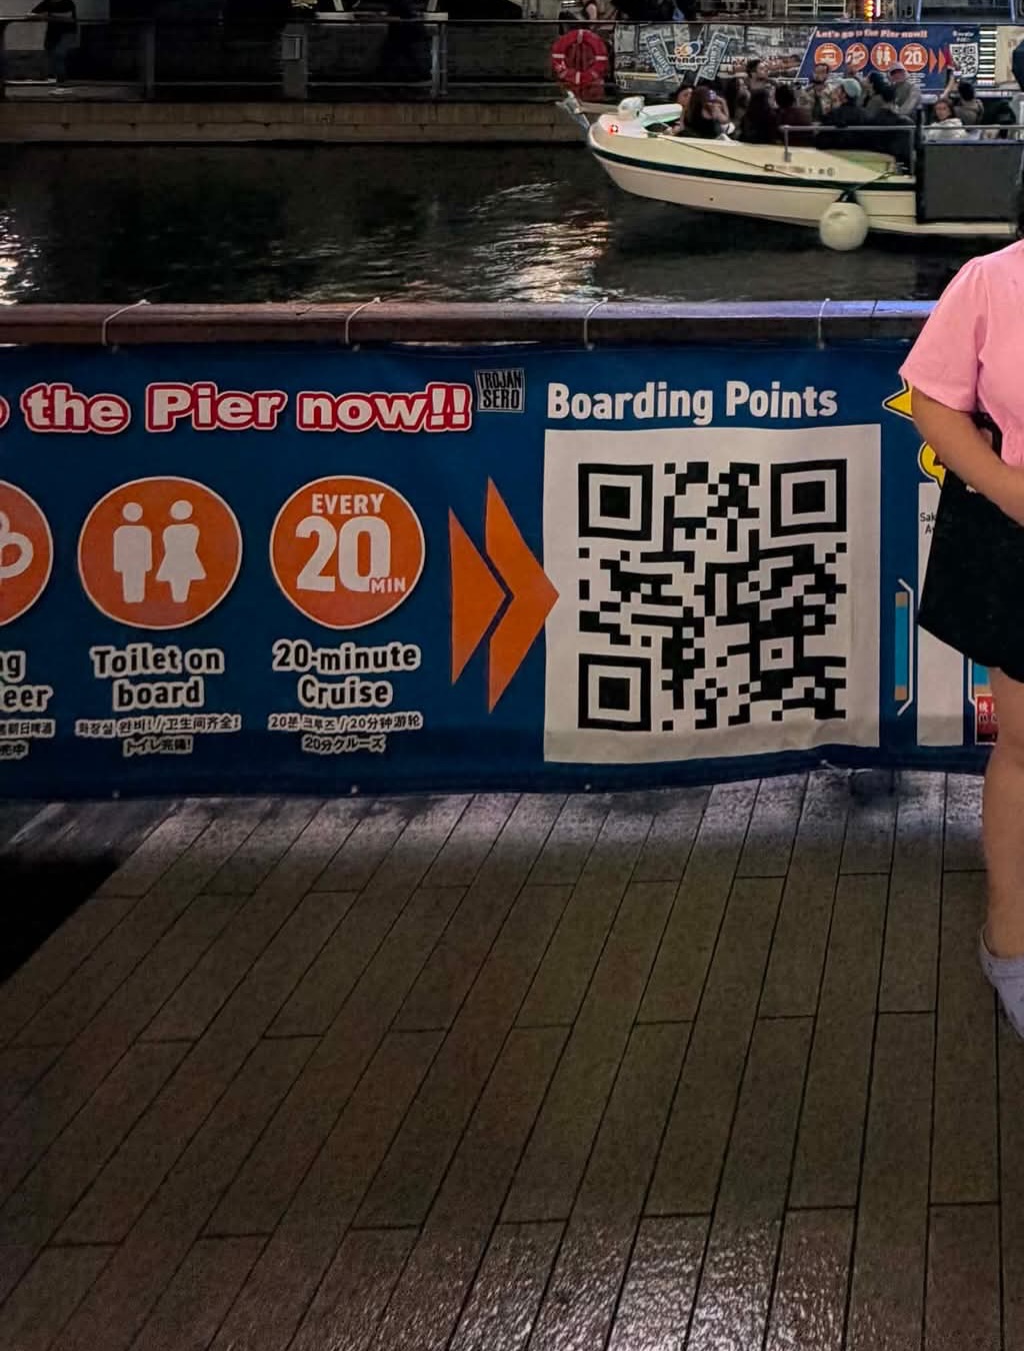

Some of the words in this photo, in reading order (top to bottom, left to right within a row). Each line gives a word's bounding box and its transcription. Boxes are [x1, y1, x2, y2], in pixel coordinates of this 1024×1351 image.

[480, 371, 522, 389] TROJAN
[25, 385, 127, 430] the
[149, 384, 287, 430] Pier
[300, 385, 468, 430] now!!
[547, 381, 714, 425] Boarding
[726, 380, 839, 417] Points
[311, 493, 385, 515] EVERY
[295, 515, 392, 593] 20
[370, 577, 406, 594] MIN
[93, 647, 179, 674] Toilet
[189, 650, 221, 670] on
[276, 643, 417, 671] 20-minute
[118, 681, 201, 707] board
[301, 679, 389, 705] Cruise
[304, 736, 385, 751] 20分クルーズ
